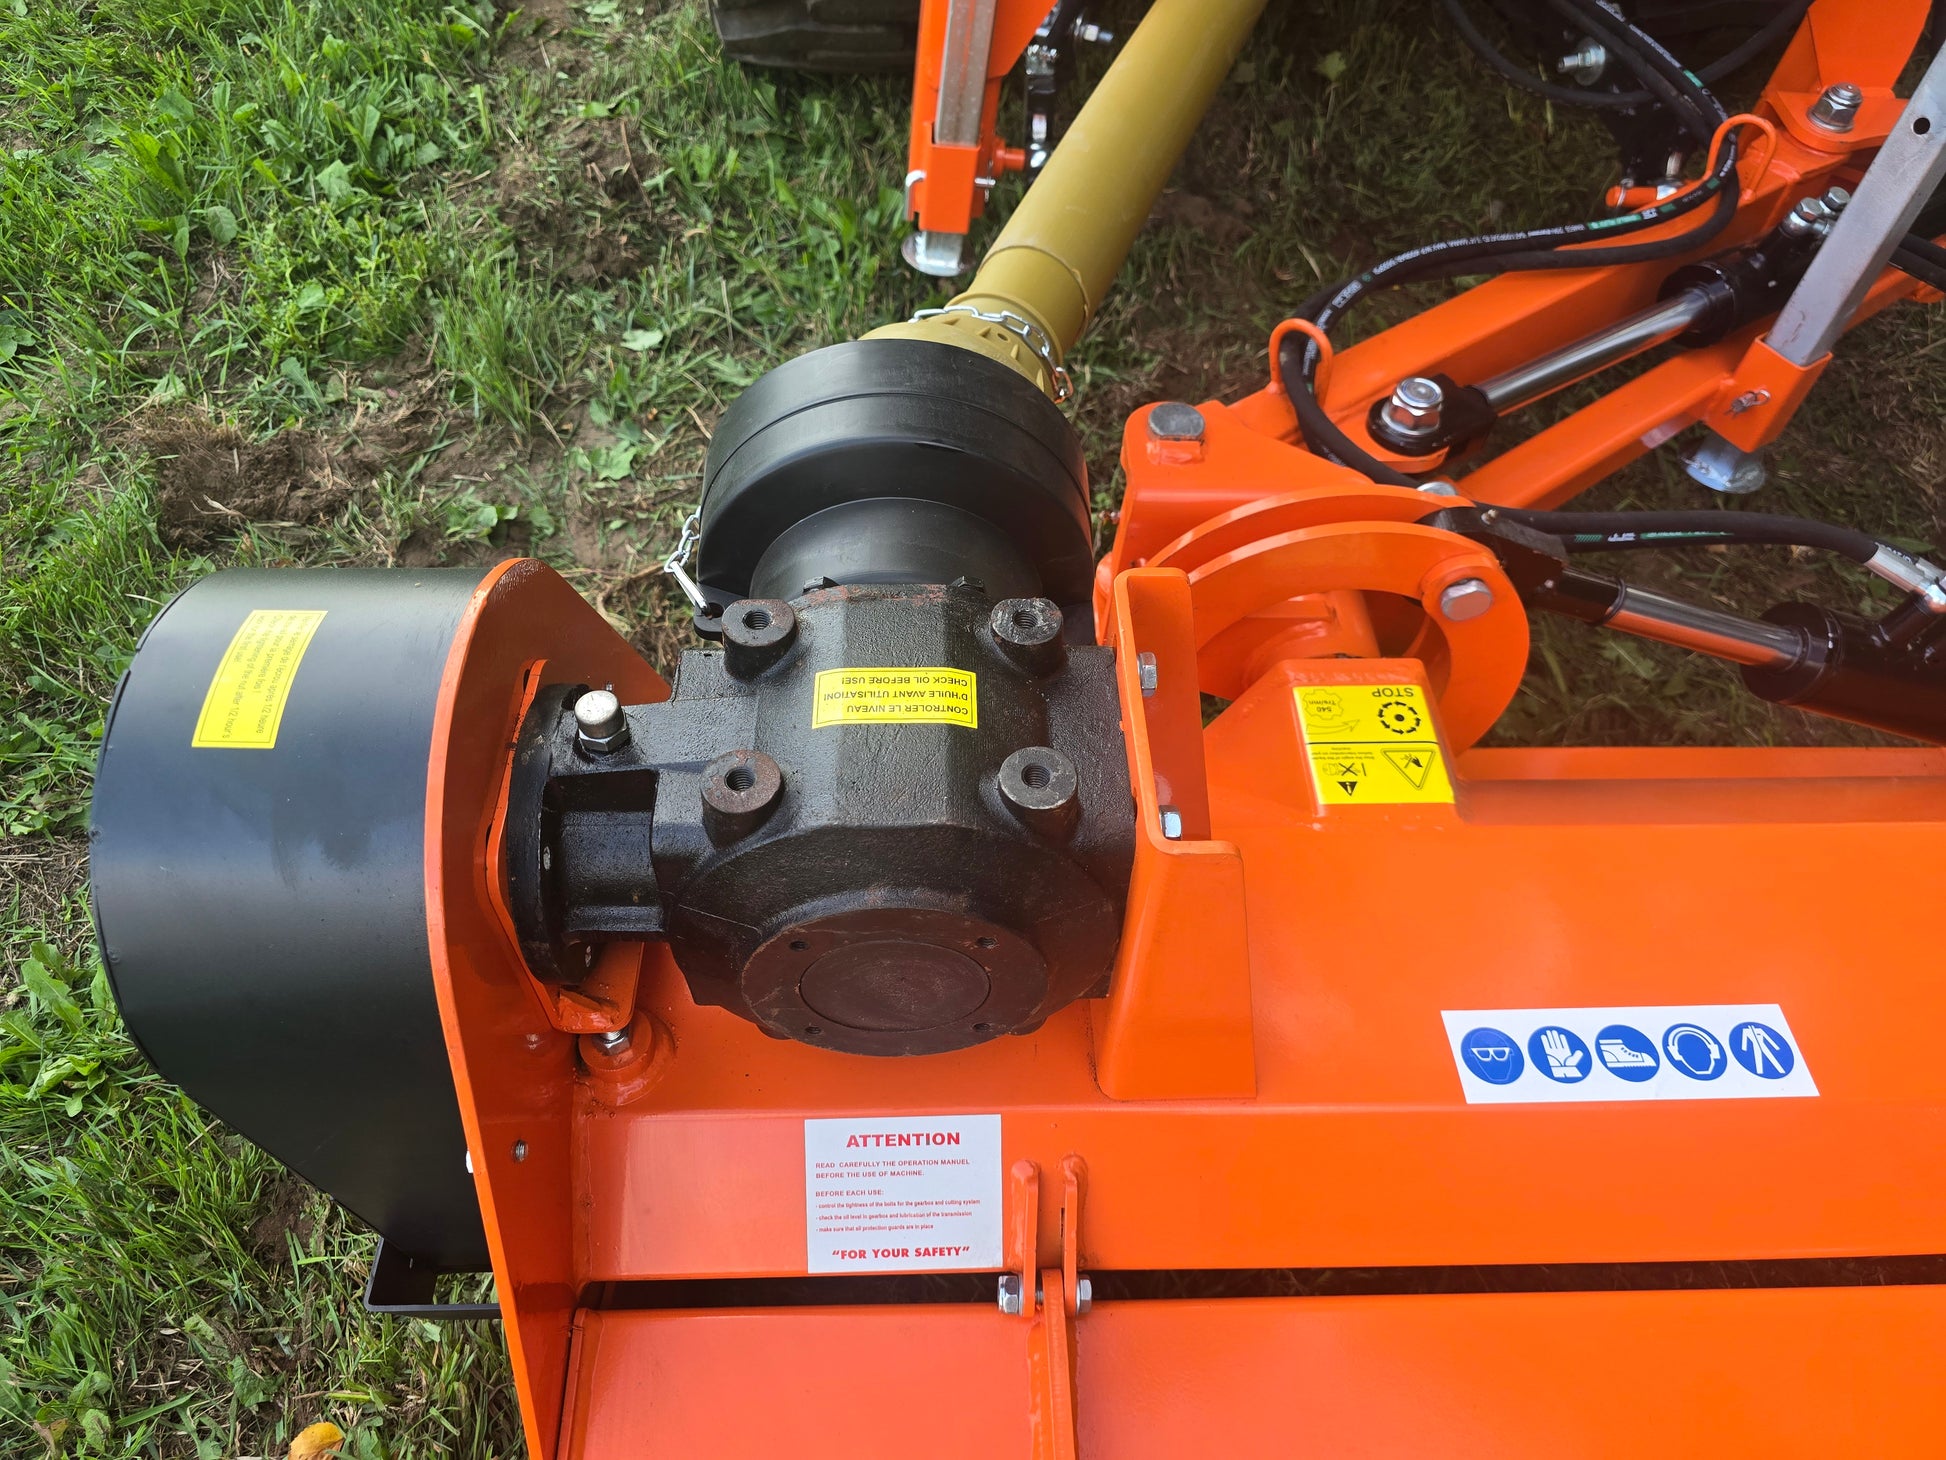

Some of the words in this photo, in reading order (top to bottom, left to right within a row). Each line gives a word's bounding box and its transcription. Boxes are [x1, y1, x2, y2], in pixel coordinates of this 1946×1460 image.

[280, 656, 289, 664] de
[842, 676, 866, 685] USE!
[868, 676, 911, 684] BEFORE
[914, 676, 930, 684] OIL
[933, 676, 968, 687] CHECK
[824, 690, 890, 701] UTILISATION!
[894, 690, 926, 698] AVANT
[929, 690, 968, 701] D'HUILE
[1371, 687, 1414, 698] STOP
[232, 691, 244, 705] after
[228, 707, 240, 717] 1/2
[261, 704, 274, 714] 1/2
[846, 704, 886, 713] NIVEAU
[888, 704, 902, 712] LE
[905, 704, 968, 715] CONTROLER
[256, 714, 270, 734] heure
[846, 1132, 960, 1148] ATTENTION
[940, 1158, 970, 1166] MANUEL
[862, 1170, 877, 1178] USE
[963, 1198, 980, 1206] system
[872, 1248, 910, 1258] YOUR
